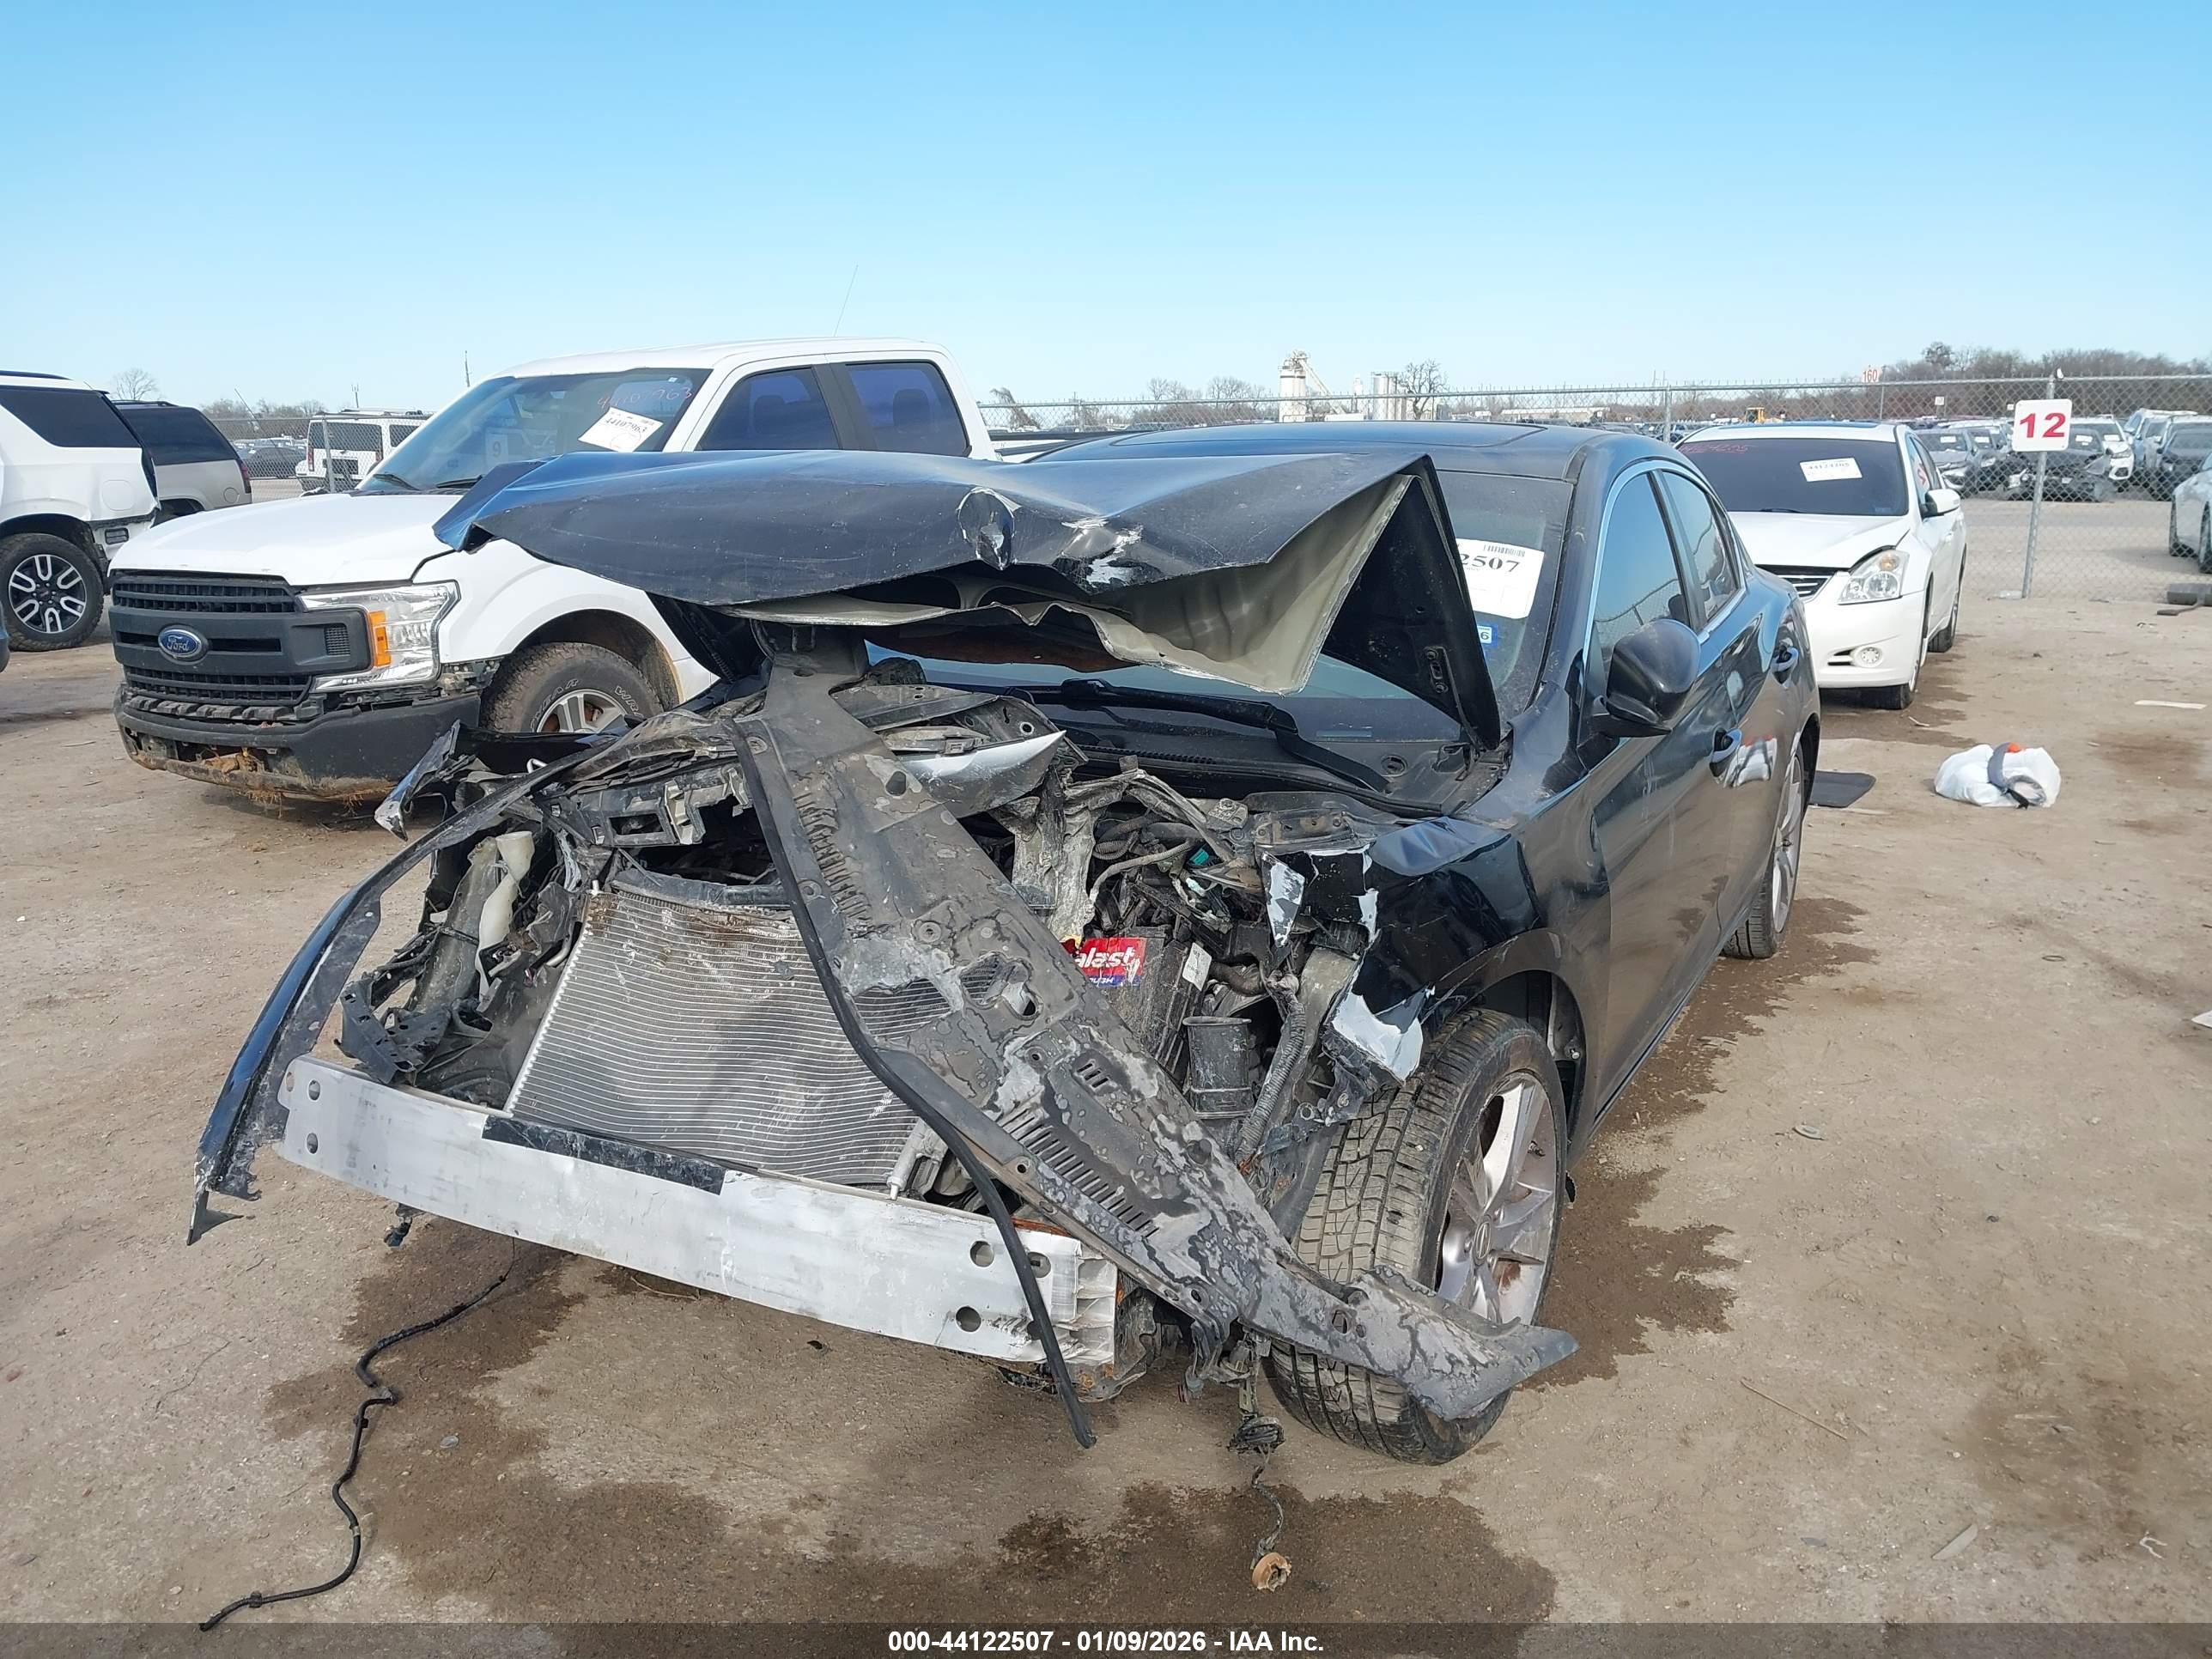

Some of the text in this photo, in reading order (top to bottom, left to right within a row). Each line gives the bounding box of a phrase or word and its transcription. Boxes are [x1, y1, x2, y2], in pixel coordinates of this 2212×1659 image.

[1863, 369, 1878, 382] 160
[2020, 412, 2066, 438] 12
[1460, 553, 1521, 573] 2507
[167, 635, 190, 651] Ford
